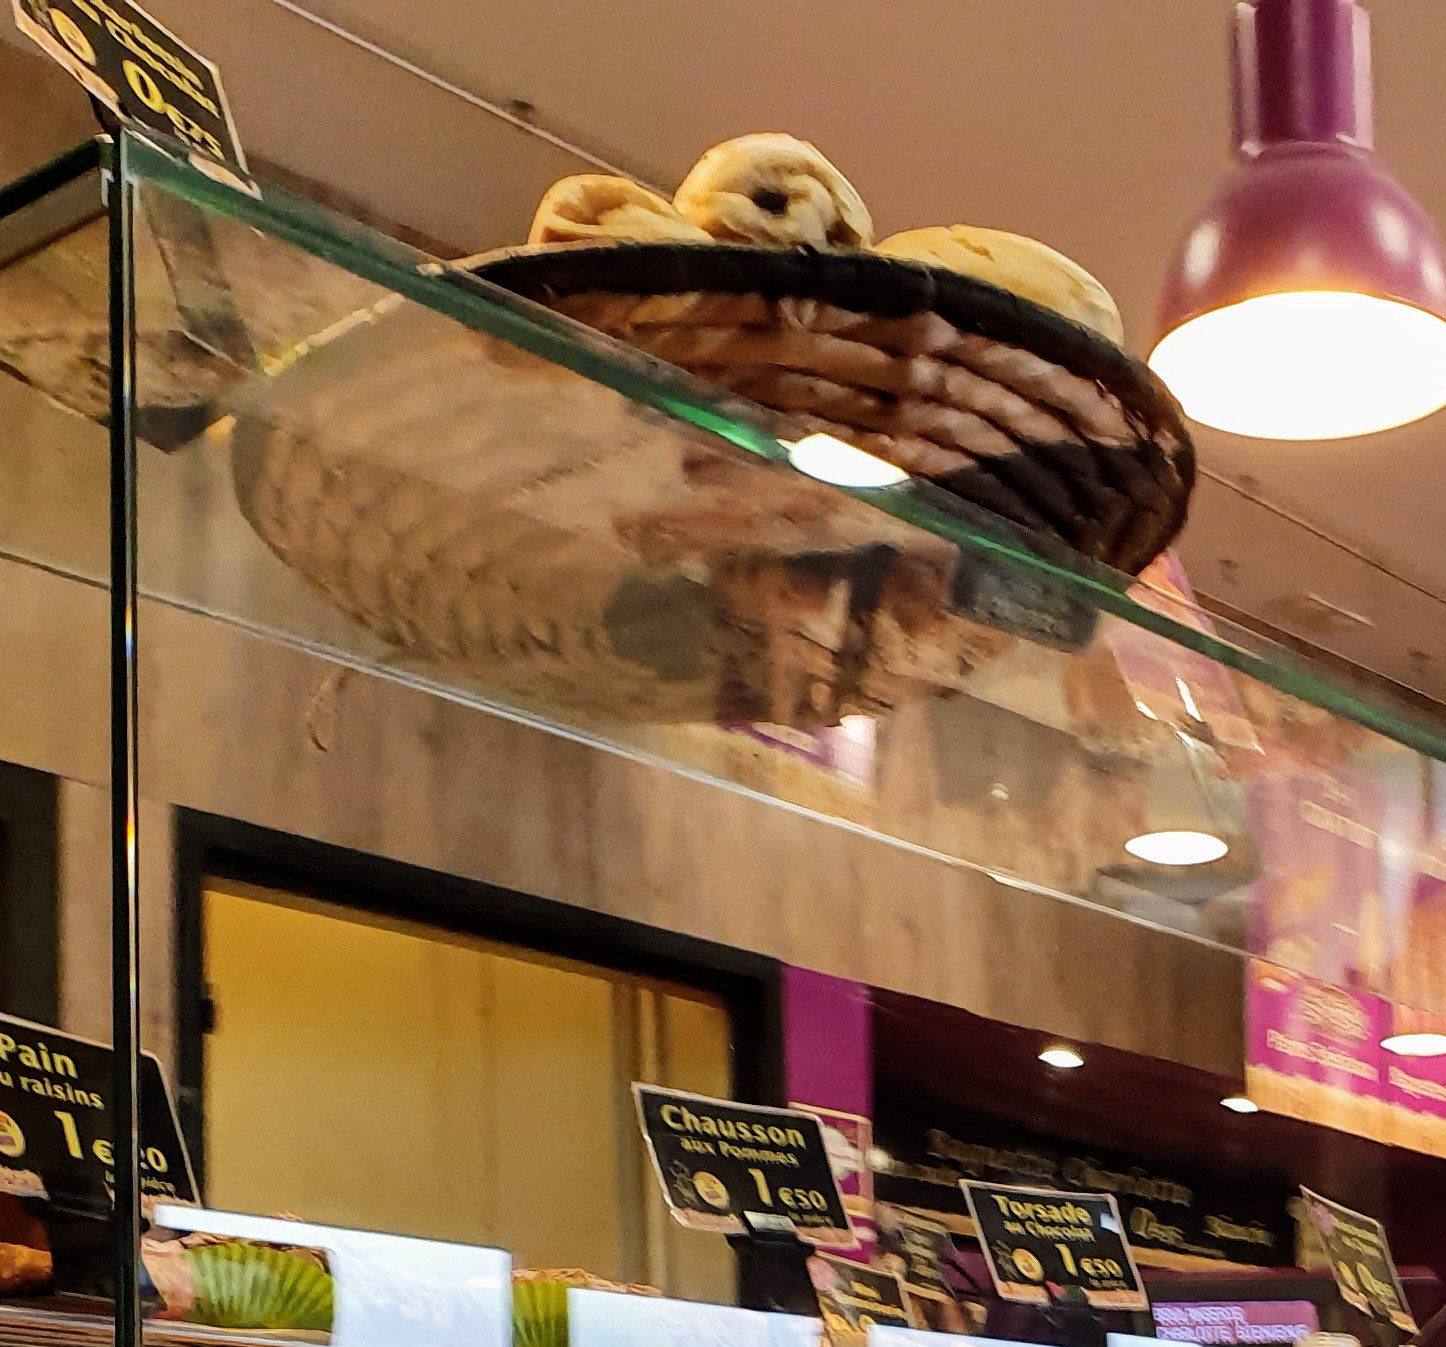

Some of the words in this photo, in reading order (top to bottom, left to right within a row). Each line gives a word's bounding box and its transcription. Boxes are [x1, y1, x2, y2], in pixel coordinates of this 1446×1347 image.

[0, 1032, 78, 1079] Pain
[19, 1074, 105, 1110] raisins
[660, 1104, 806, 1149] Chausson
[680, 1136, 717, 1156] aux
[991, 1194, 1094, 1226] Torsade
